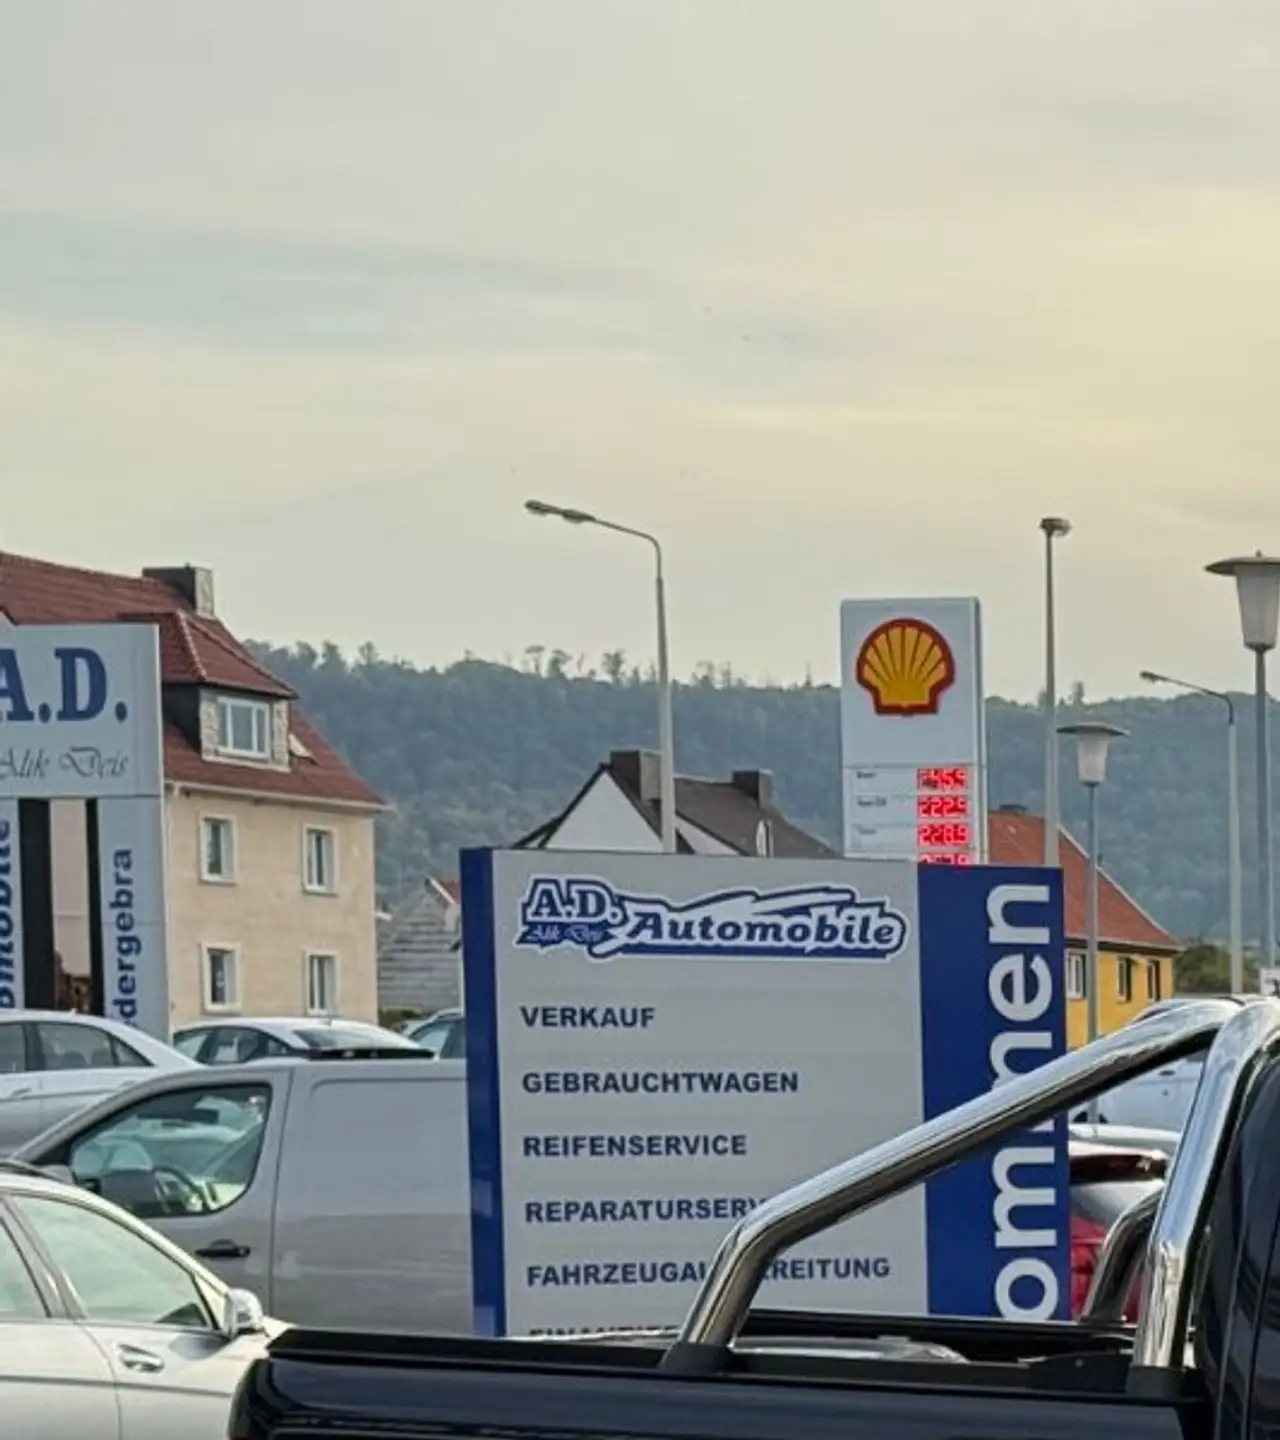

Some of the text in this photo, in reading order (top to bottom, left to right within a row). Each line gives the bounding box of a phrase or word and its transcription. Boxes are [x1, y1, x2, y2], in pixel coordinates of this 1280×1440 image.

[109, 849, 141, 1024] dergebra
[627, 908, 895, 944] Automobile
[520, 1006, 655, 1028] VERKAUF
[522, 1072, 799, 1093] GEBRAUCHTWAGEN
[523, 1135, 747, 1157] REIFENSERVICE
